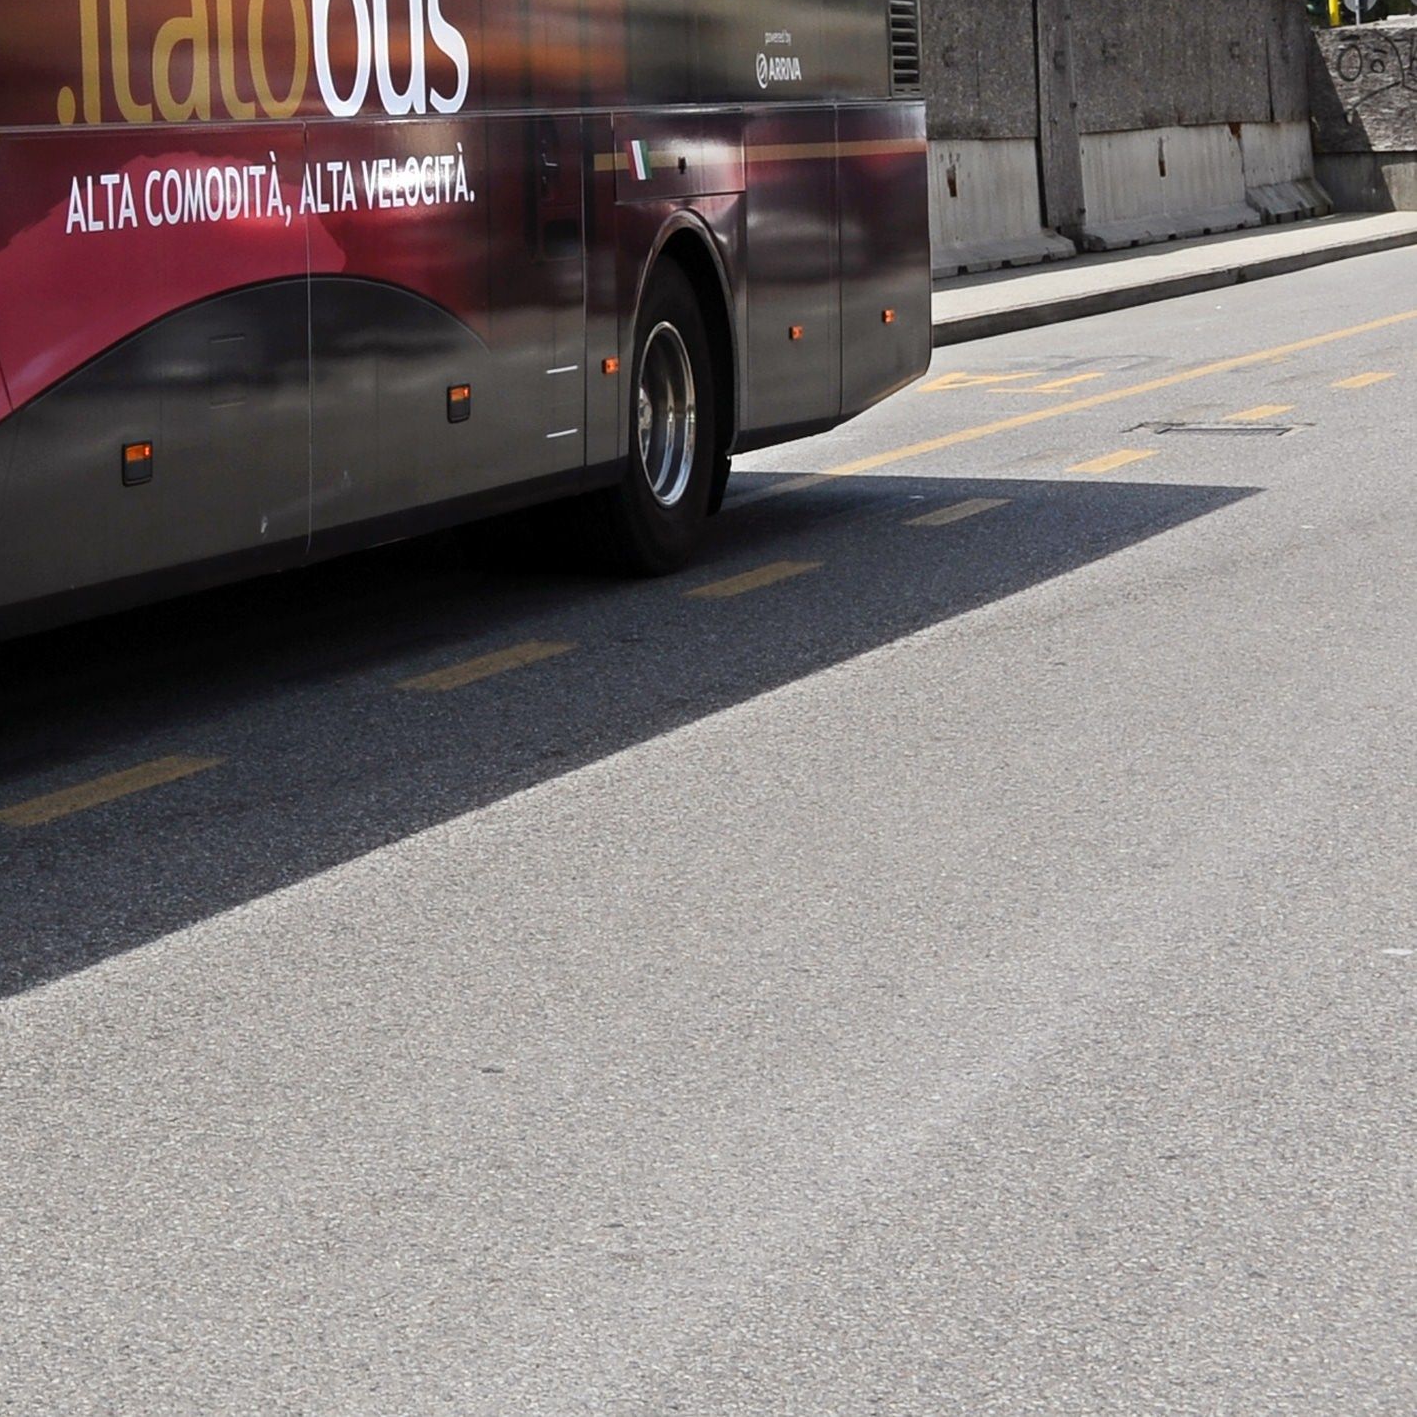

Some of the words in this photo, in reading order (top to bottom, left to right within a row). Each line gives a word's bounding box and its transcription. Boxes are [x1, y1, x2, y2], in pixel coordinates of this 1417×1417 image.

[768, 57, 802, 81] ARRIVA
[66, 171, 138, 234] ALTA
[144, 150, 292, 227] COMODITÀ,
[299, 160, 357, 215] ALTA
[362, 142, 476, 210] VELOCITÀ.
